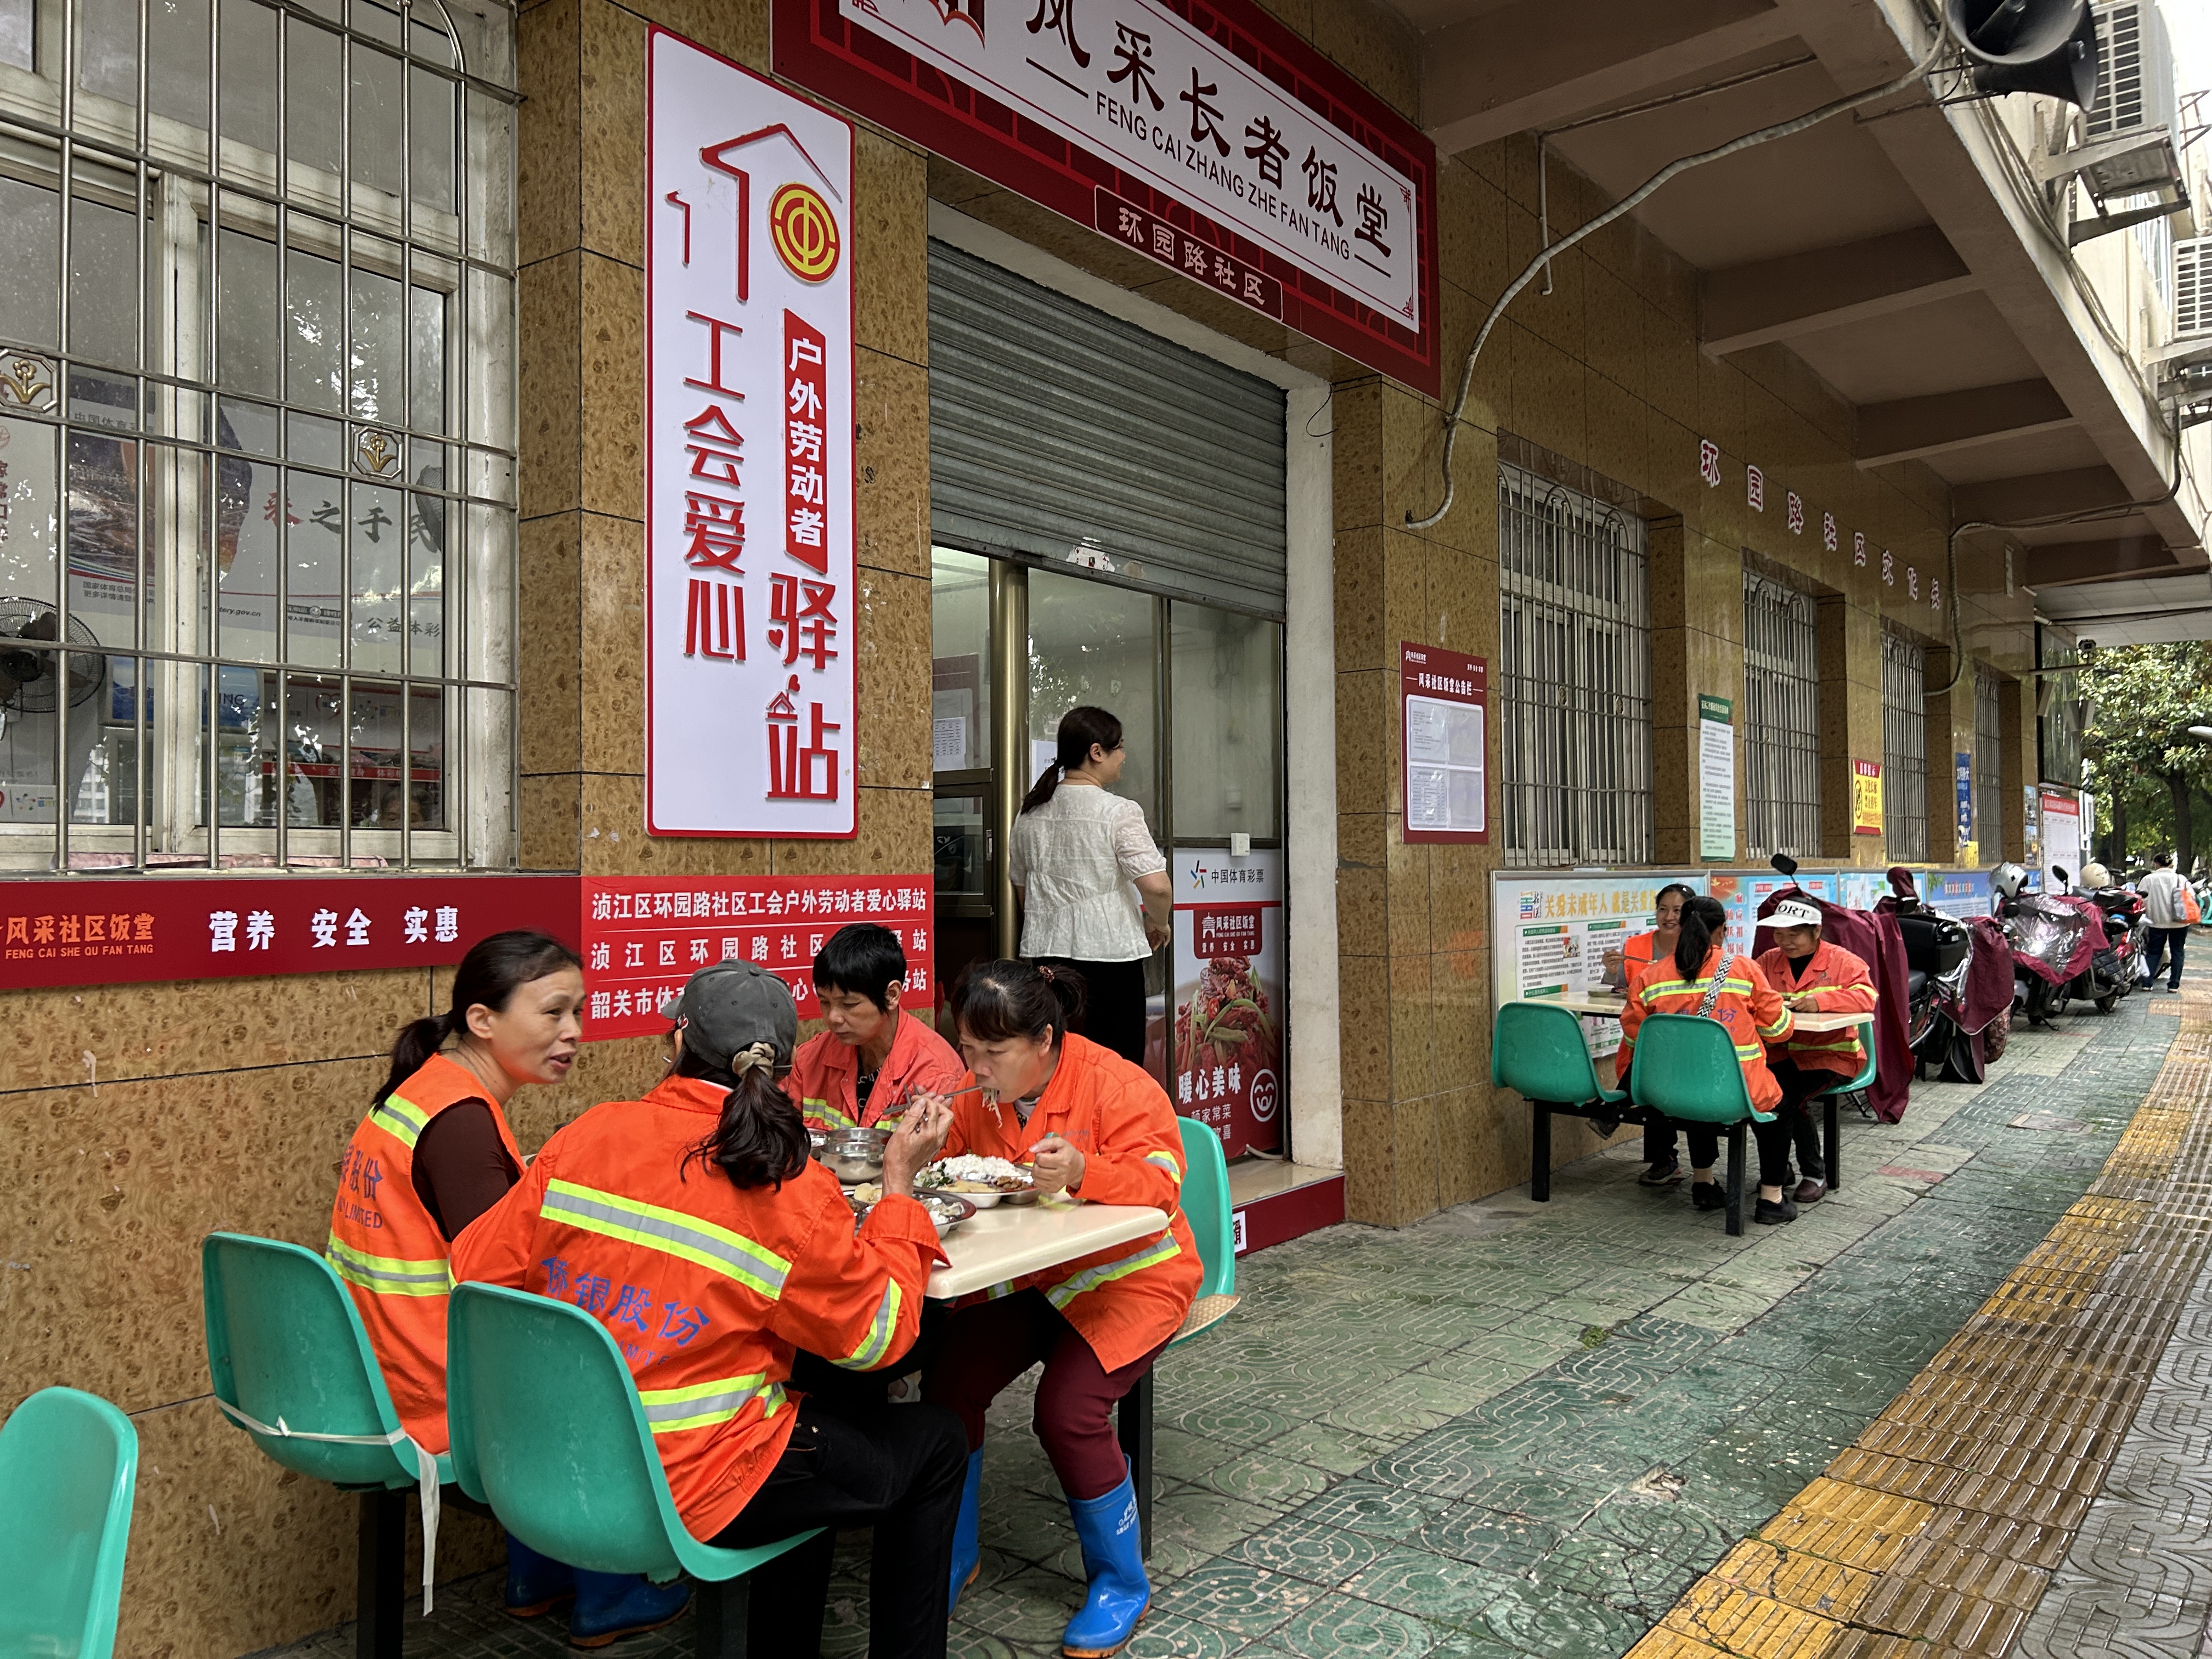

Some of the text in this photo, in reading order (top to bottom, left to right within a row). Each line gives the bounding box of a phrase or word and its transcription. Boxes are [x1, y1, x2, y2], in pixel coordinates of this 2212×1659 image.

[1025, 0, 1392, 258] 风采长者饭堂
[1097, 91, 1350, 261] FENG CAI ZHANG ZHE FAN TANG
[1119, 206, 1265, 305] 环园路社区
[683, 310, 746, 662] 工会爱心
[789, 337, 823, 549] 户外劳动者
[766, 572, 840, 801] 驿站
[592, 888, 927, 921] 浈江区环园路社区工会户外劳动者爱心驿站
[1211, 868, 1264, 884] 中国体育彩票
[5, 912, 155, 945] 风采社区饭堂
[5, 944, 154, 959] FENG CAI SHE QU FAN TANG
[208, 905, 459, 952] 营养 安全 实惠
[1178, 1062, 1241, 1104] 暖心美味
[541, 1256, 710, 1347] 侨银股份
